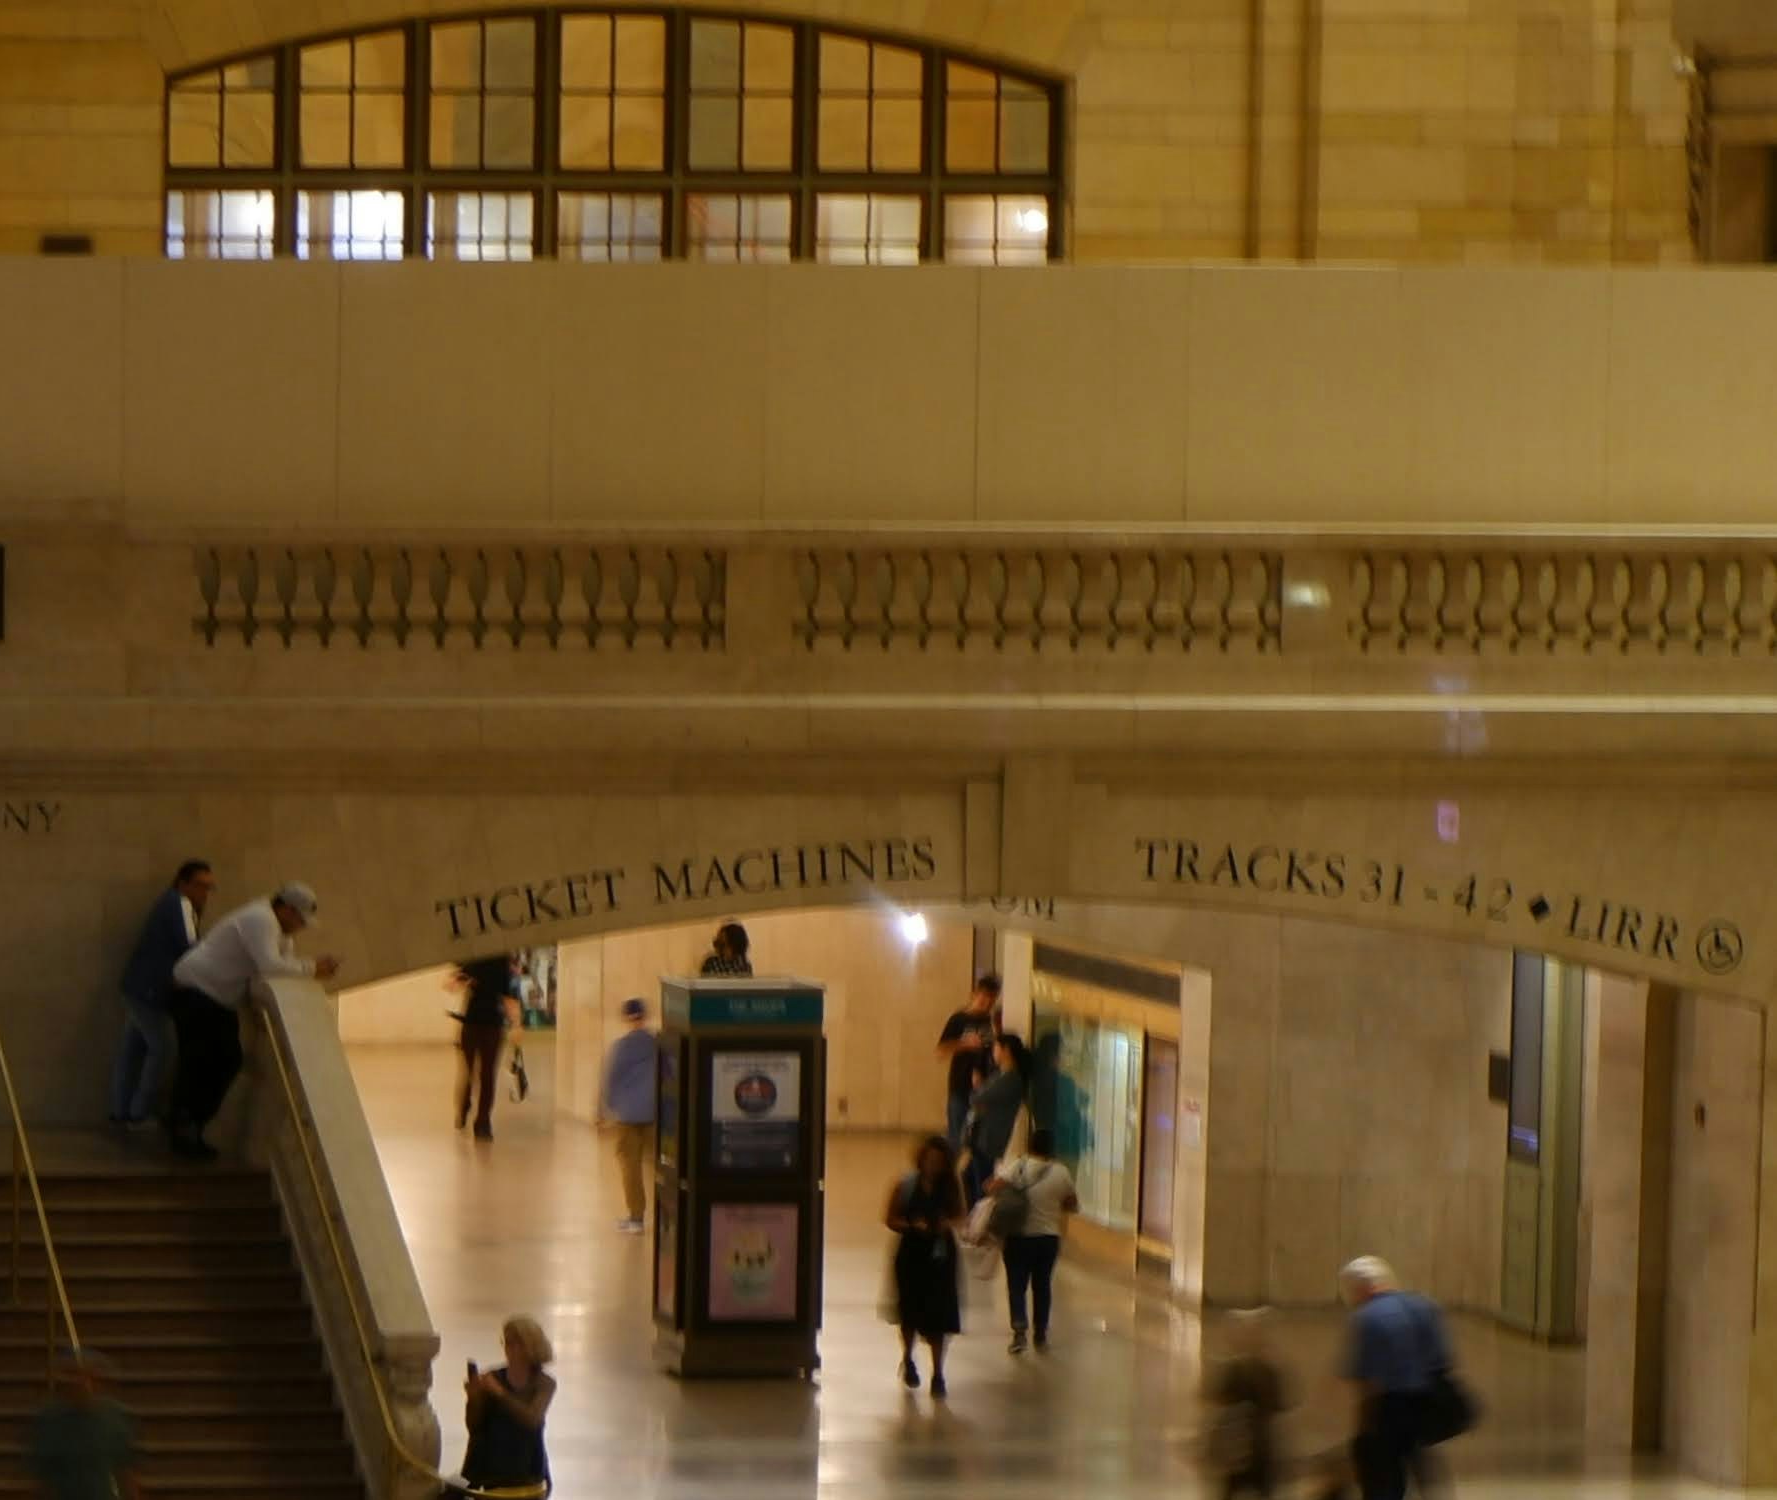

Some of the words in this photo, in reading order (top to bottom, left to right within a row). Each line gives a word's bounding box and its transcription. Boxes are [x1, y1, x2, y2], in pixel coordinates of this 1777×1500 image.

[435, 868, 625, 940] TICKET
[652, 837, 936, 904] MACHINES
[1135, 837, 1347, 898] TRACKS
[1361, 861, 1404, 908] 31
[1454, 872, 1512, 920] 42
[1564, 895, 1681, 963] LIRR
